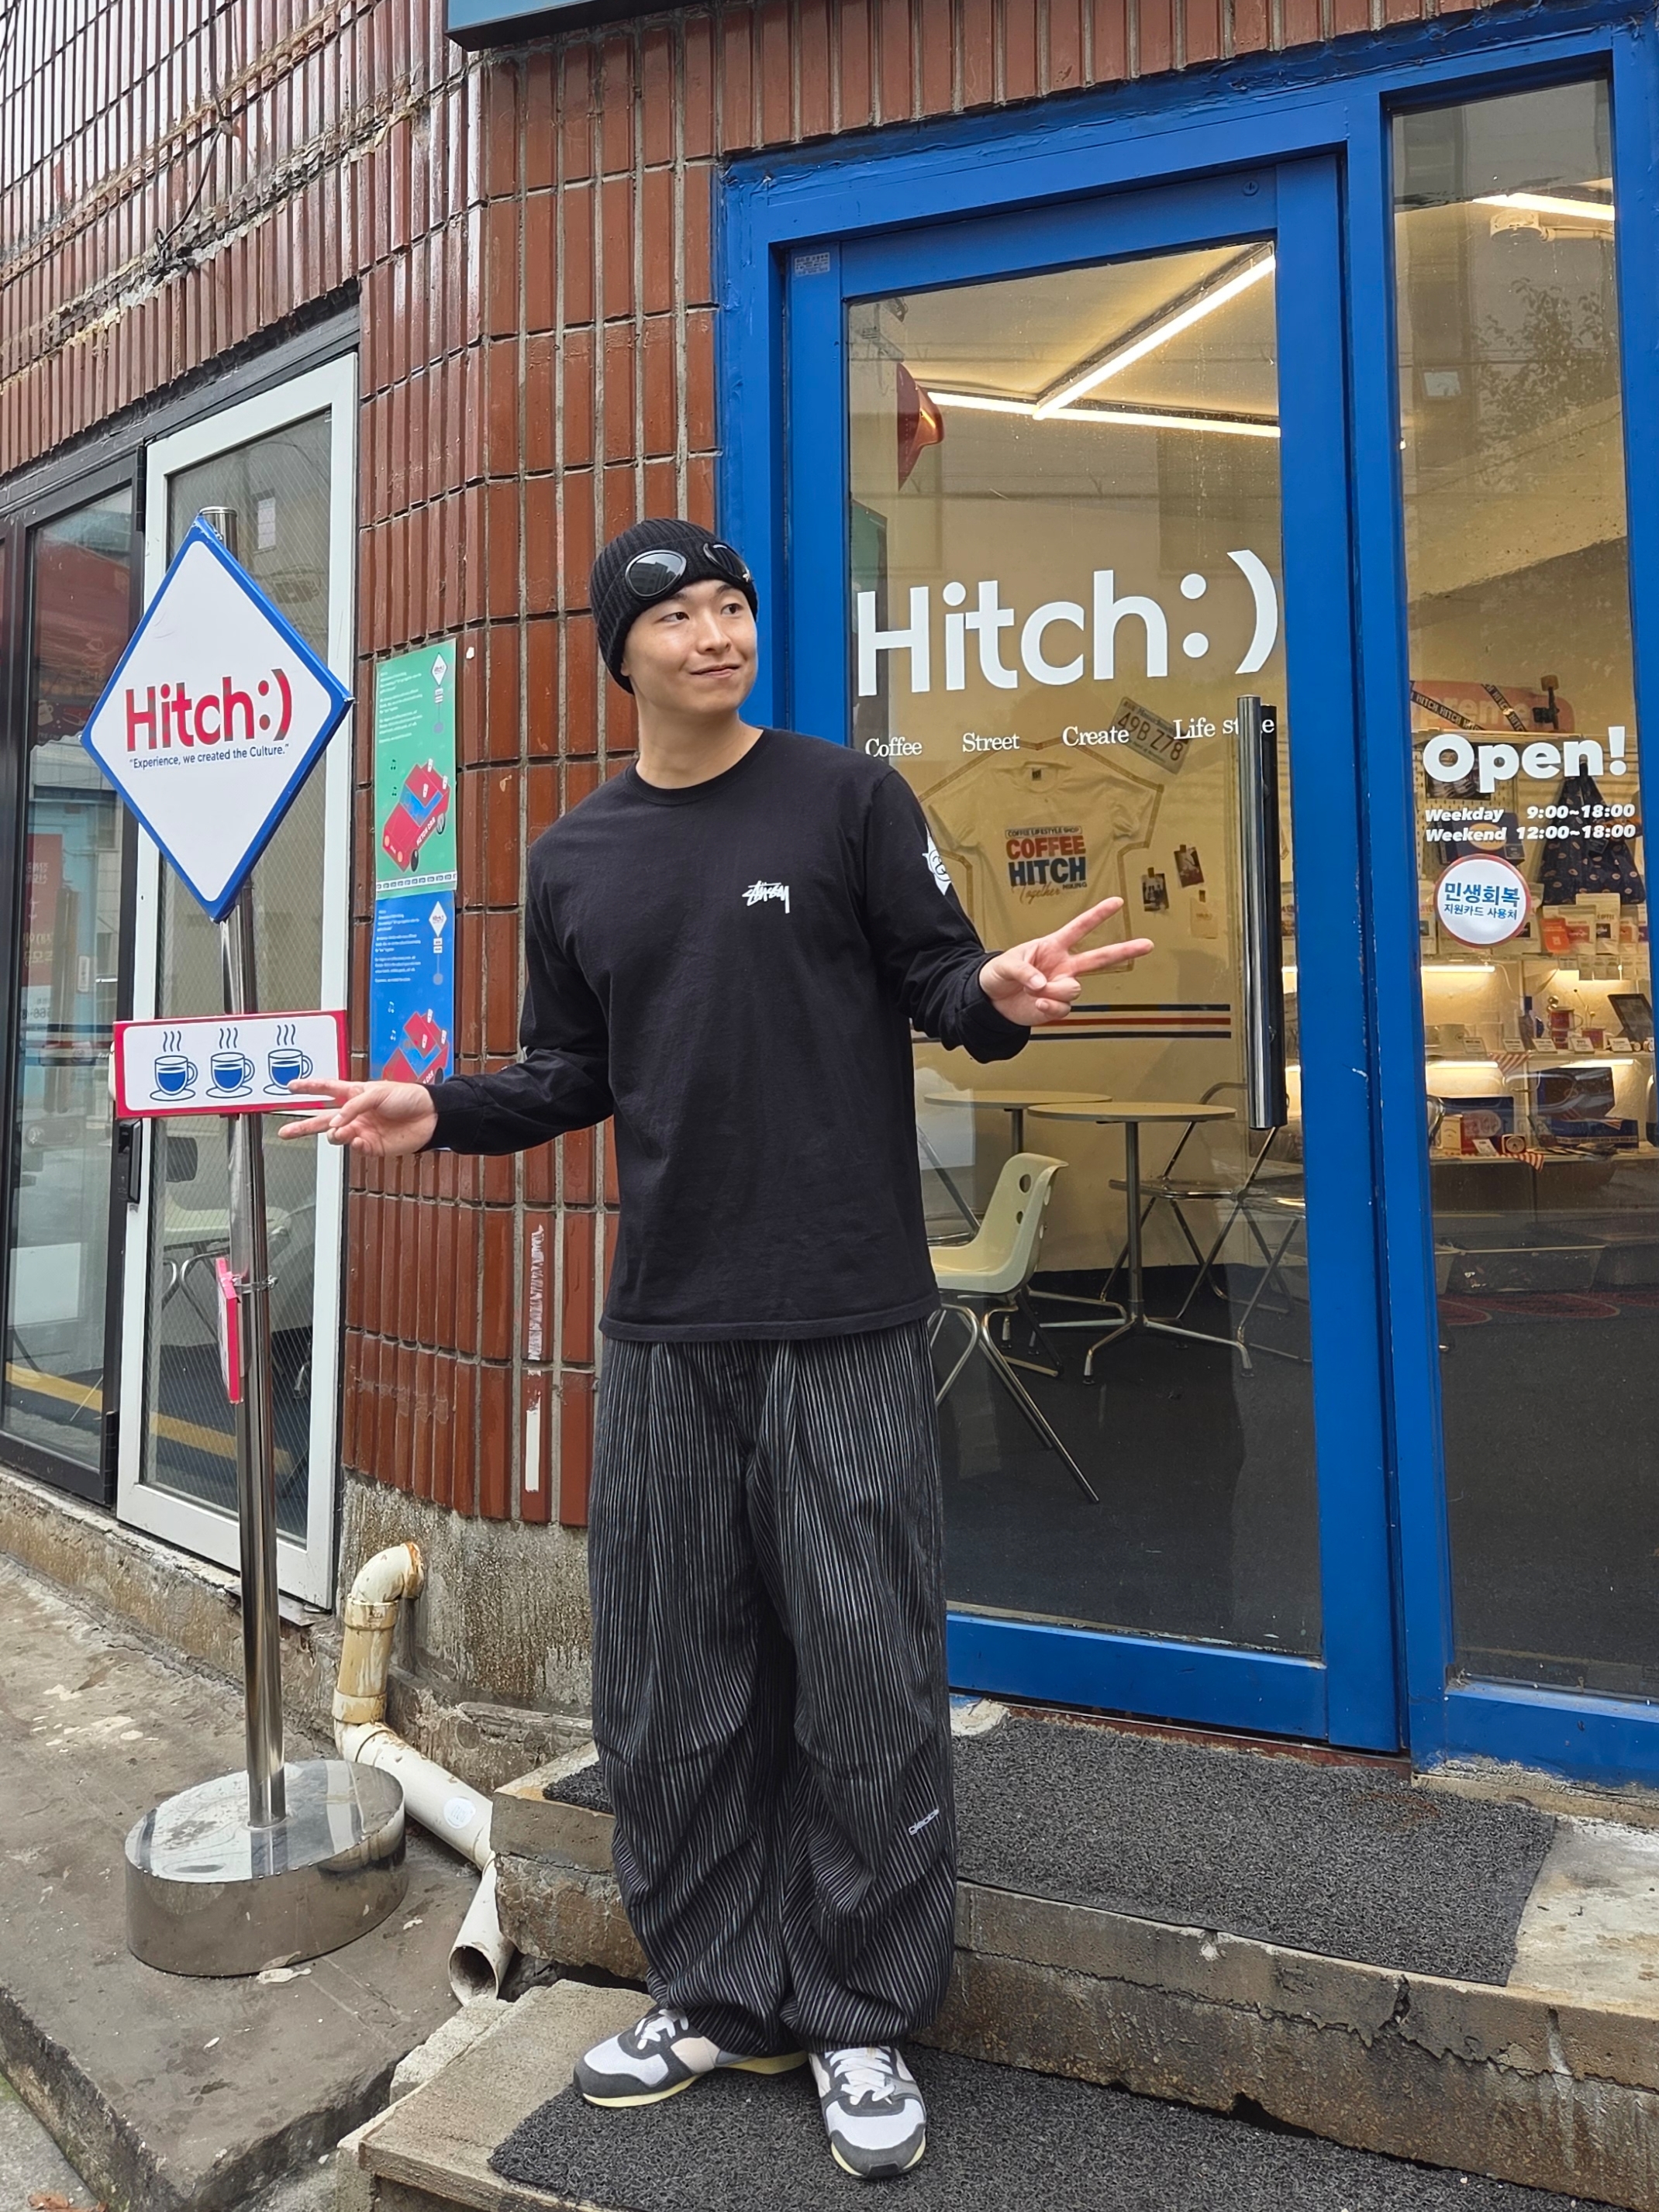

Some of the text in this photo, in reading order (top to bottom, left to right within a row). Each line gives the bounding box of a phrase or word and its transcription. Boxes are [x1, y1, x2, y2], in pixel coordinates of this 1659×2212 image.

[857, 549, 1278, 697] Hitch:)
[125, 668, 292, 753] Hitch:)
[864, 736, 923, 757] Coffee
[962, 732, 1020, 753] Street
[1062, 725, 1130, 746] Create
[1172, 717, 1216, 740] Life
[1222, 717, 1275, 736] ste
[183, 754, 195, 763] we
[197, 748, 231, 763] created
[233, 746, 247, 759] the
[1423, 725, 1627, 794] Open!
[1425, 803, 1636, 823] Weekday 9:00~18:00
[1426, 825, 1637, 842] Weekend 12:00~18:00
[1005, 835, 1087, 860] COFFEE
[1008, 856, 1086, 887] HITCH
[1443, 881, 1521, 908] 민생회복
[1443, 903, 1485, 918] 지원카드
[1487, 906, 1518, 921] 사용처
